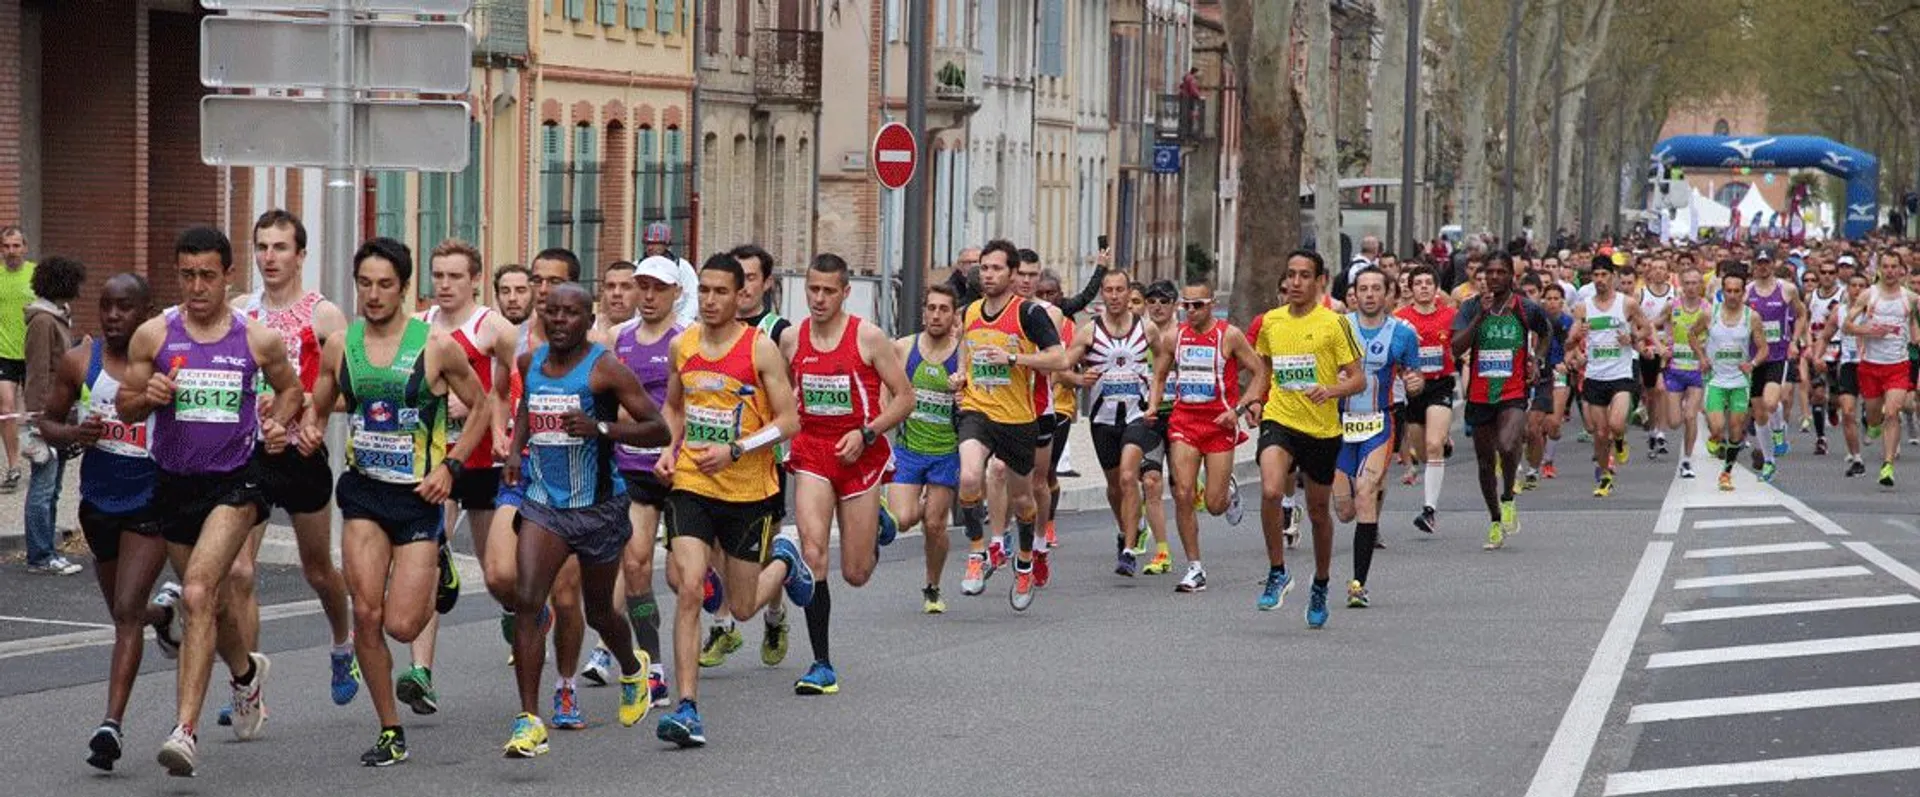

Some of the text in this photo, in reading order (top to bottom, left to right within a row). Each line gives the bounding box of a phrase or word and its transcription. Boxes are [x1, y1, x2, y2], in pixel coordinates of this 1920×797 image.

[178, 389, 239, 409] 4612
[805, 389, 849, 404] 3730
[687, 423, 730, 442] 3124
[357, 449, 409, 468] 2264
